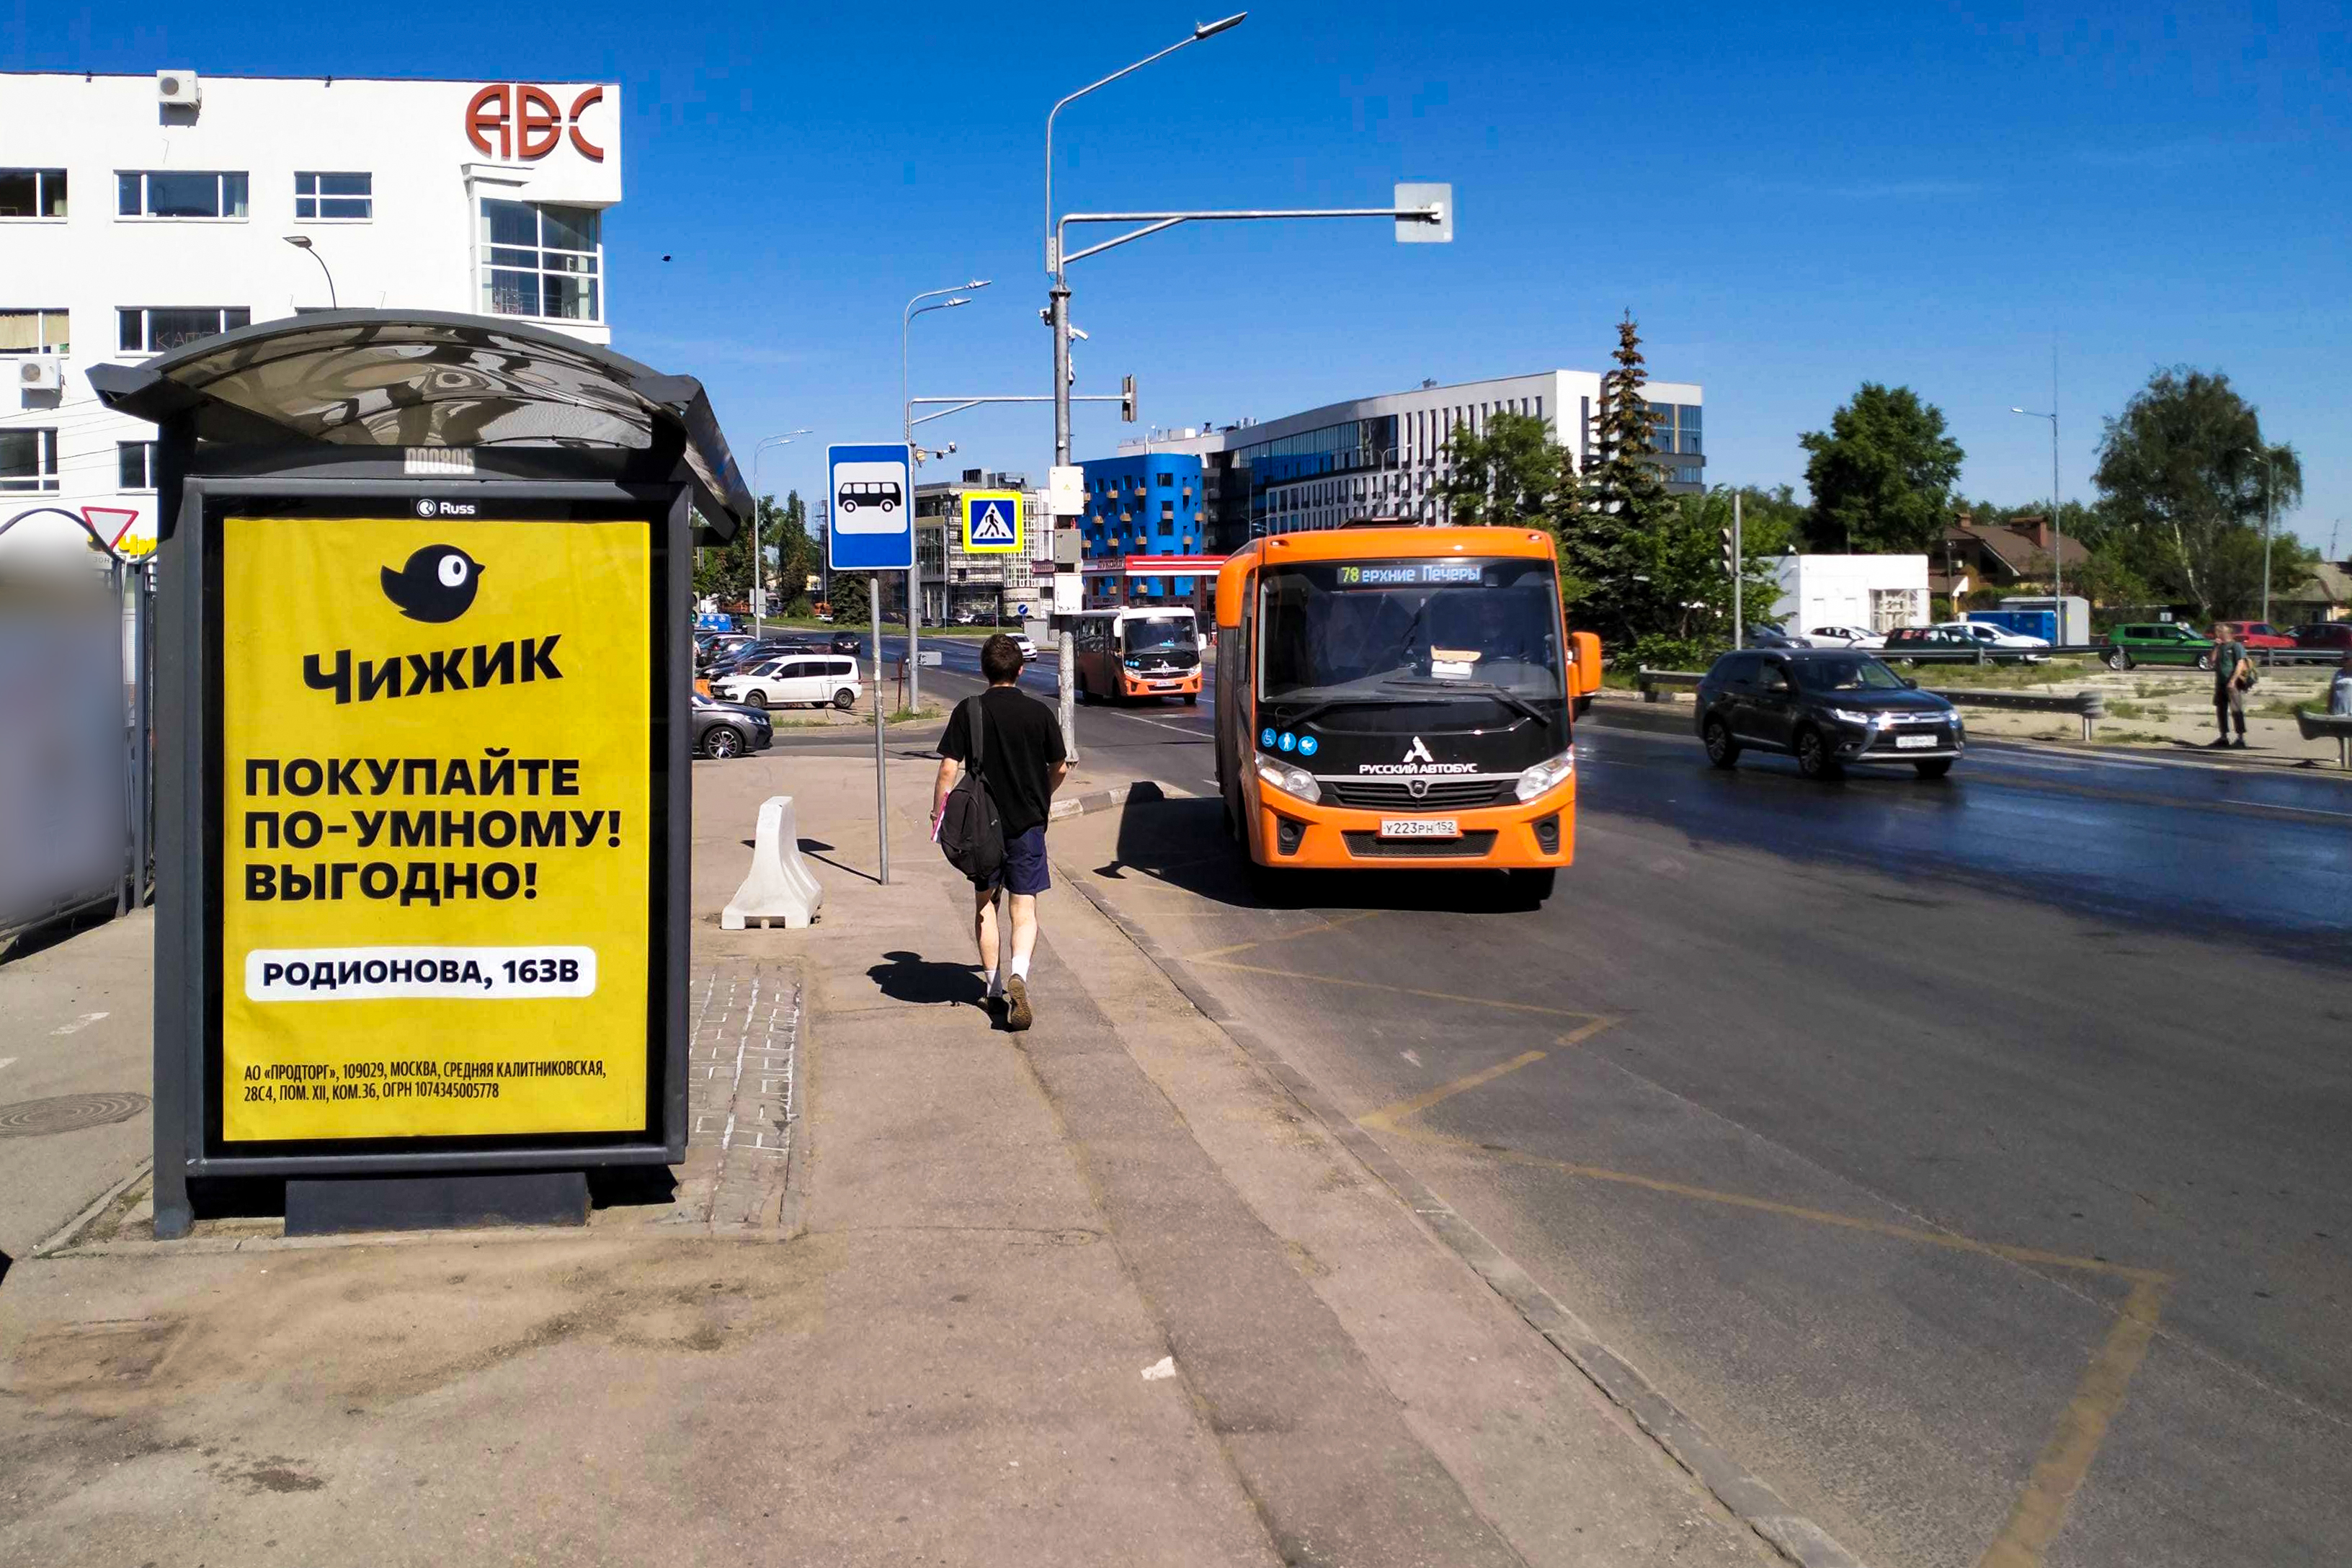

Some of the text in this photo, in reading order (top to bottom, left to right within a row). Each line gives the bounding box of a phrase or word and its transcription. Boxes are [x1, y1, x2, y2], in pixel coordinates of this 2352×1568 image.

[440, 502, 476, 514] Russ
[1342, 565, 1481, 582] 78 ерхние Печеры
[245, 747, 579, 796] ПОКУПАЙТЕ
[1359, 763, 1477, 774] РУССКИЙ АВТОБУС
[245, 811, 621, 848] ПО-УМНОМУ!
[245, 863, 537, 906] ВЫГОДНО!
[263, 959, 579, 990] РОДИОНОВА, 163В
[244, 1060, 607, 1083] АО «ПРОДТОРГ», 109029, МОСКВА, СРЕДНЯЯ КАЛИТНИКОВСКАЯ,
[244, 1085, 276, 1103] 28С4,
[280, 1084, 309, 1101] ПОМ.
[383, 1082, 412, 1098] ОГРН
[415, 1082, 499, 1099] 1074345005778
